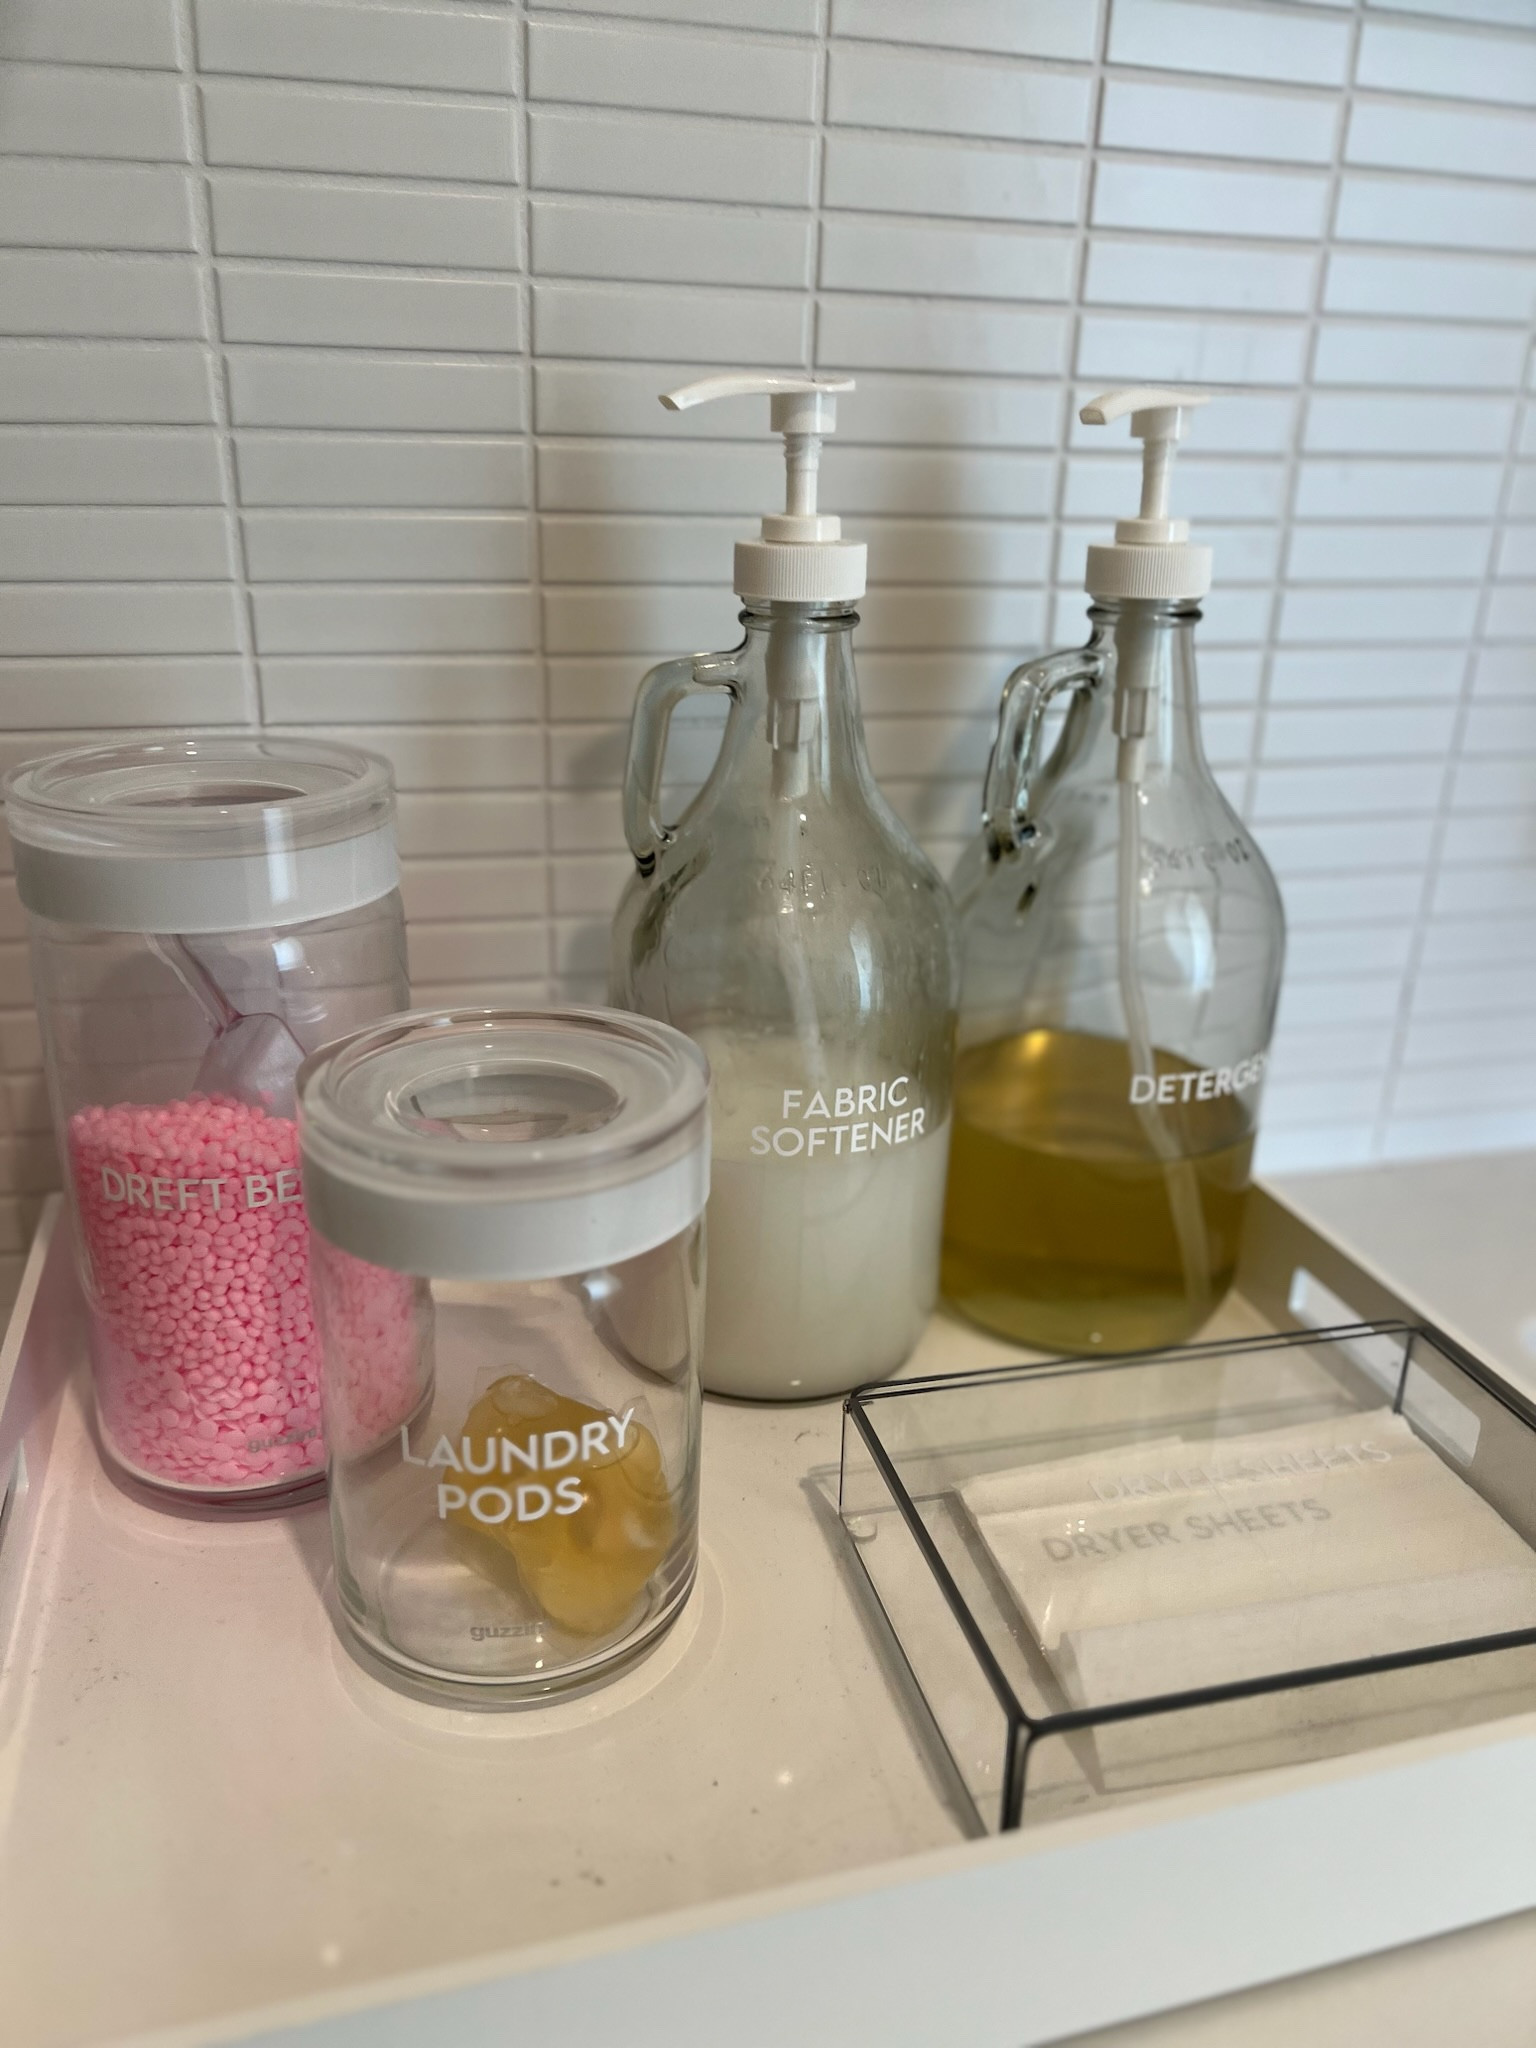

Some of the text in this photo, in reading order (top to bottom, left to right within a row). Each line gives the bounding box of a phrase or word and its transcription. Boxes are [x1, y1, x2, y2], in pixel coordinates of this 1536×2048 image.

[782, 1076, 909, 1119] FABRIC
[751, 1107, 925, 1157] SOFTENER
[100, 1167, 301, 1211] DREFT BE
[401, 1407, 635, 1475] LAUNDRY
[437, 1477, 584, 1524] PODS
[1041, 1498, 1333, 1562] DRYER SHEETS
